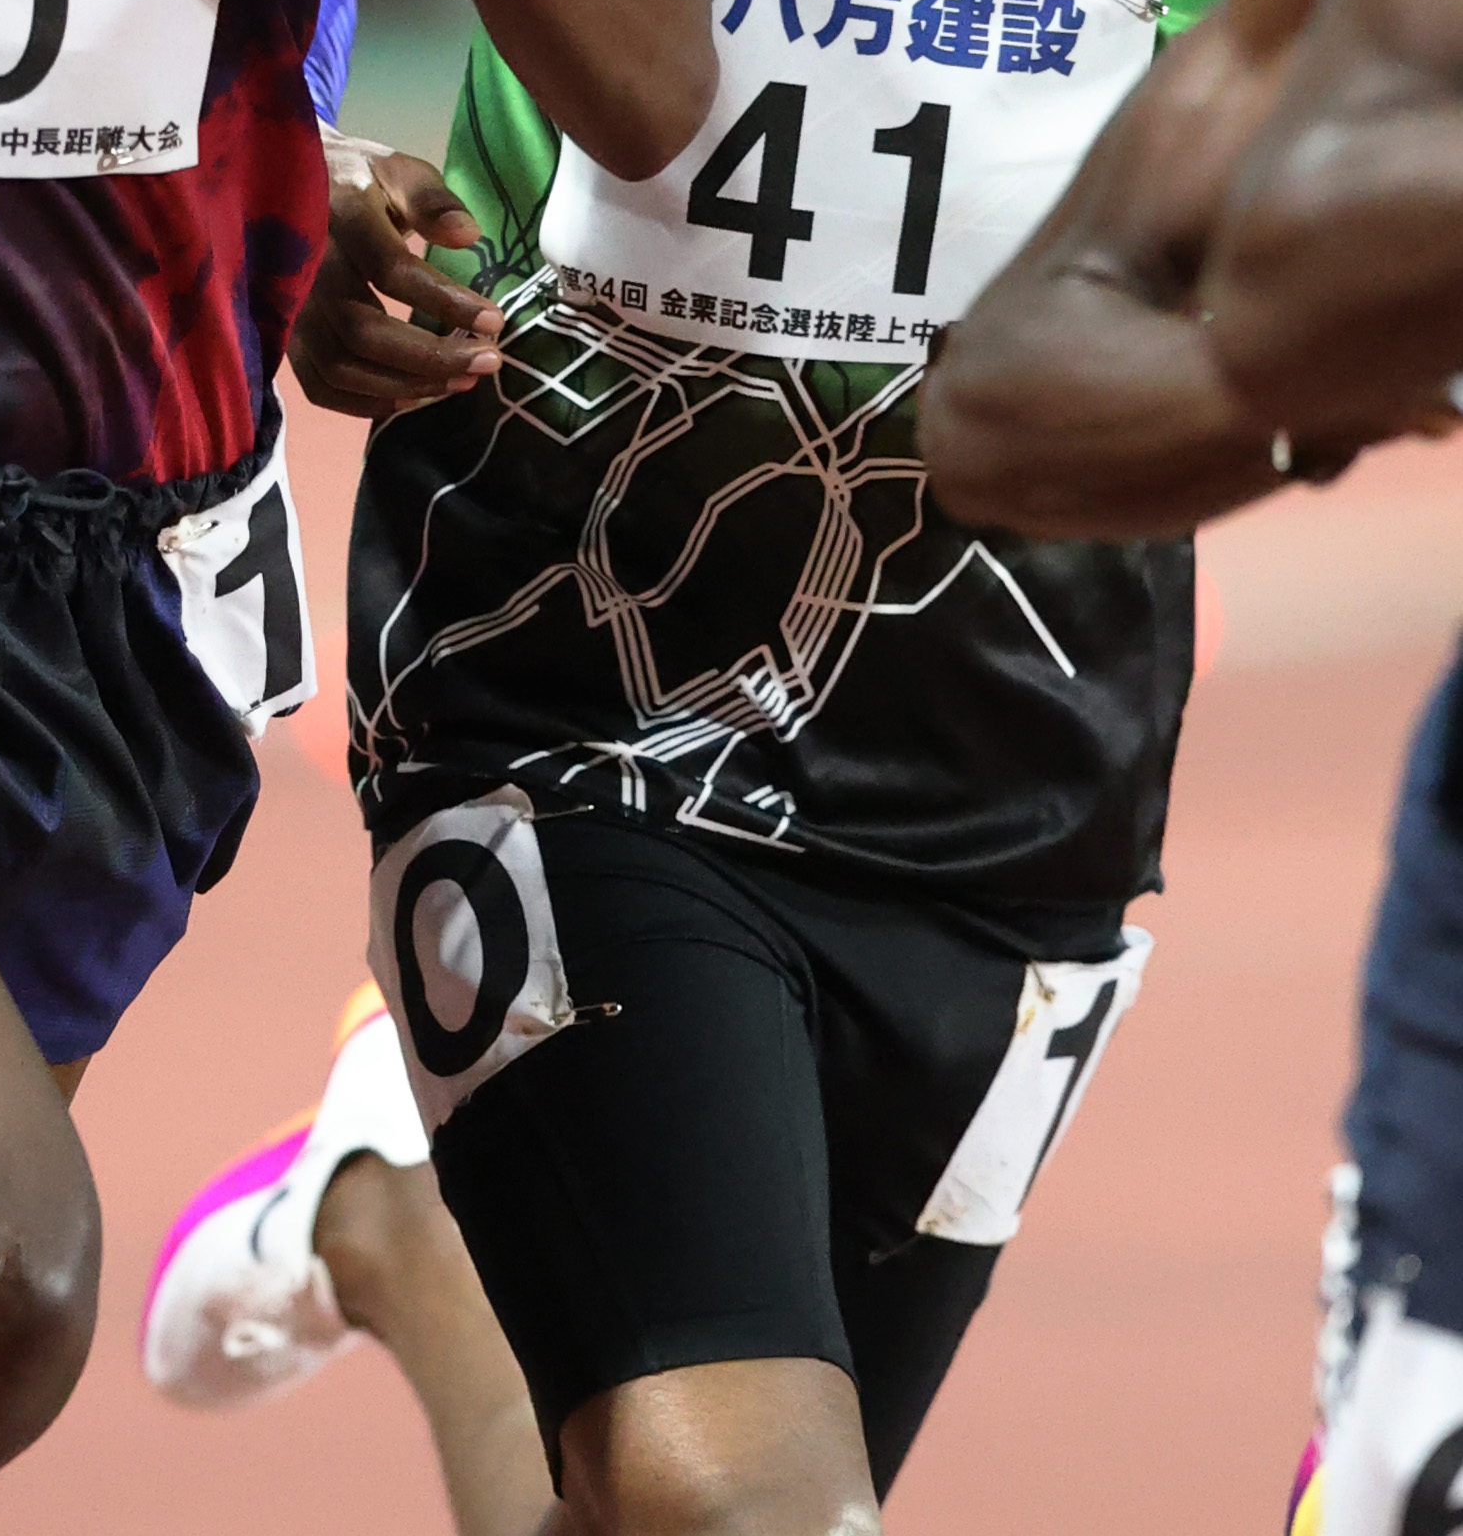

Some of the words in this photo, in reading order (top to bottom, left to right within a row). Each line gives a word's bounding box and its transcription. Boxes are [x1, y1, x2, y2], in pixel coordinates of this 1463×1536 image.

[686, 80, 951, 294] 41
[215, 481, 303, 702] 1
[1016, 979, 1118, 1213] 1
